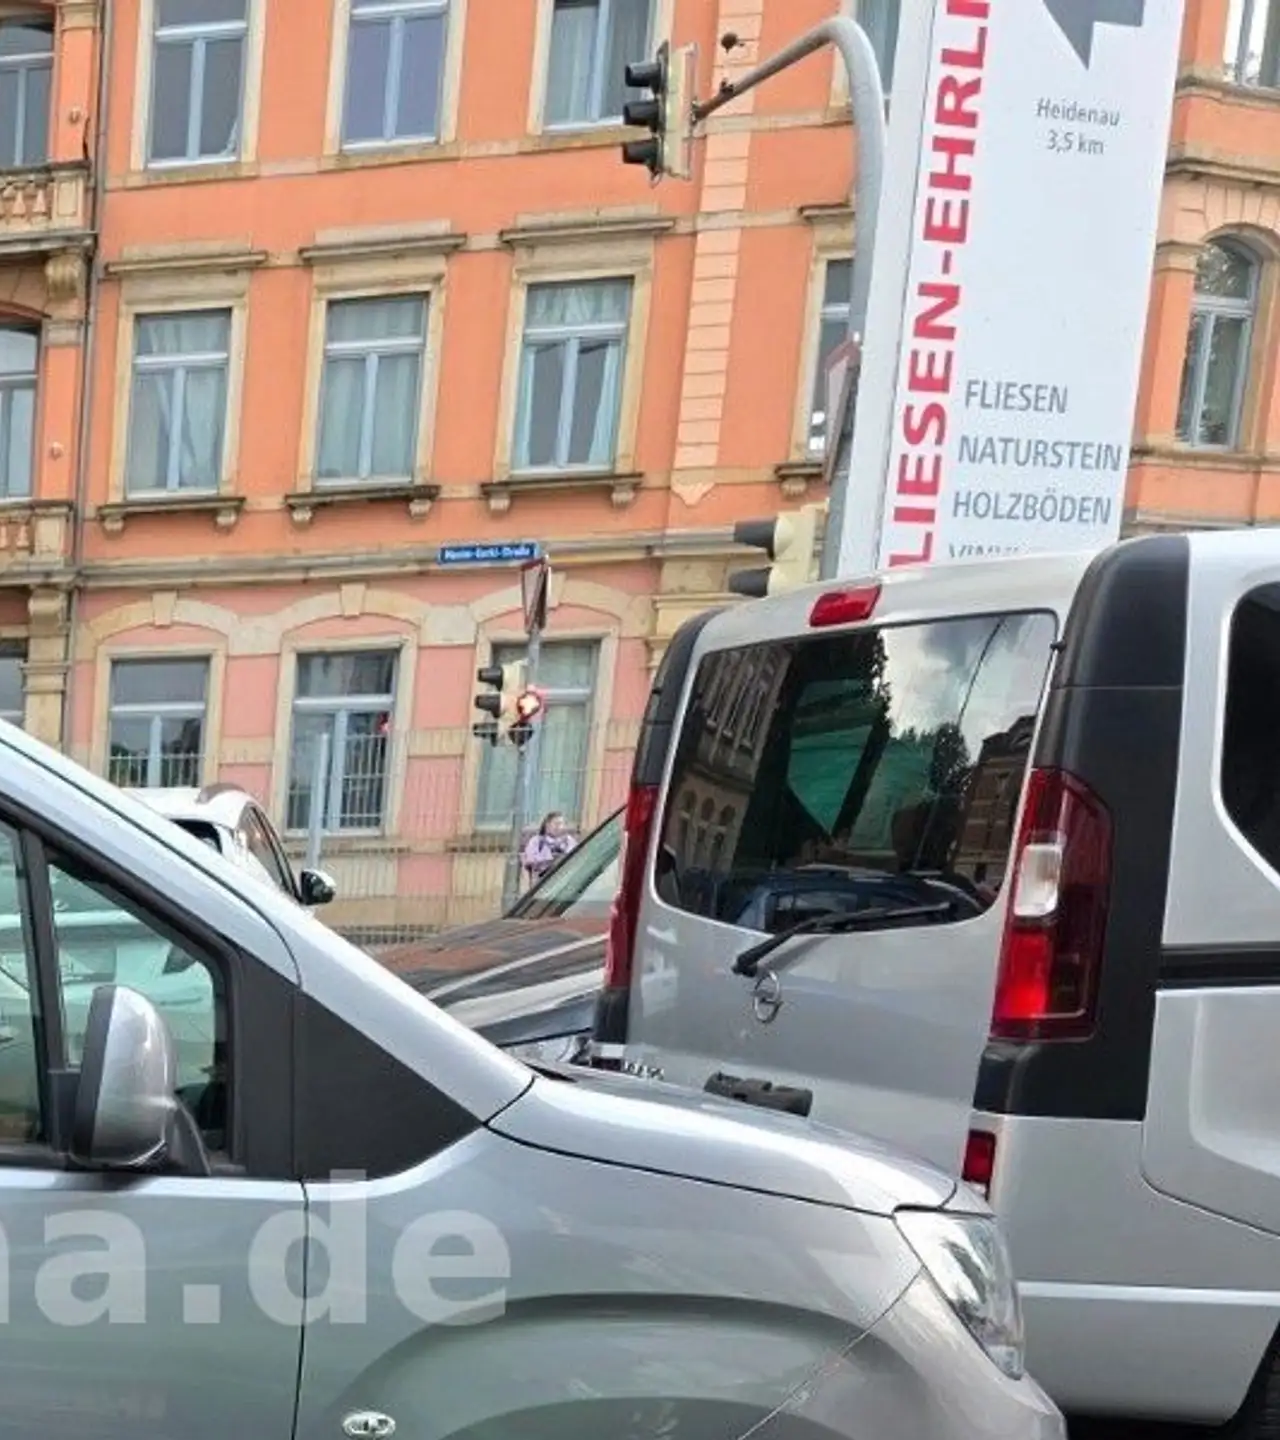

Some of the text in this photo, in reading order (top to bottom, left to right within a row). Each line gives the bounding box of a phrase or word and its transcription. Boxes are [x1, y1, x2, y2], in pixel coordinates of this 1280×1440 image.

[1036, 98, 1120, 126] Heidenau
[1047, 130, 1104, 155] 3,5 km
[965, 380, 1068, 414] FLIESEN
[958, 435, 1122, 471] NATURSTEIN
[952, 487, 1111, 524] HOLZBÖDEN
